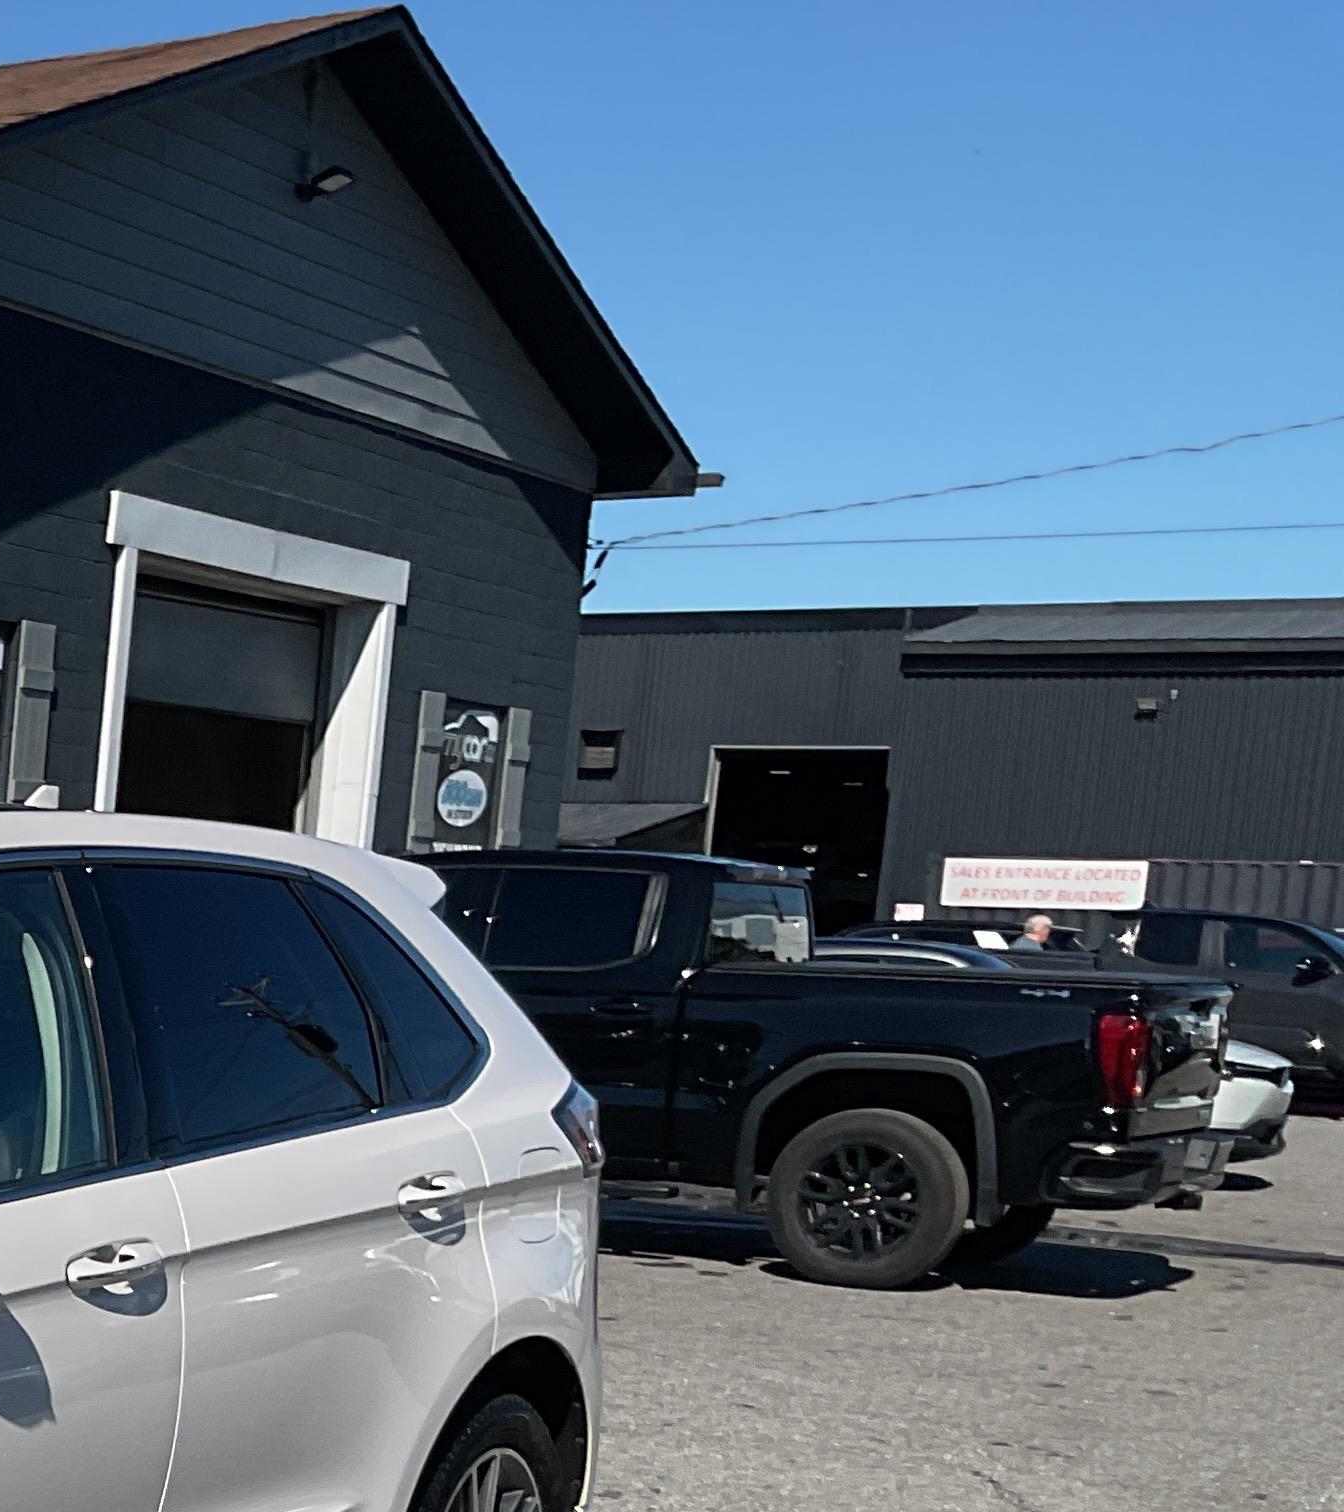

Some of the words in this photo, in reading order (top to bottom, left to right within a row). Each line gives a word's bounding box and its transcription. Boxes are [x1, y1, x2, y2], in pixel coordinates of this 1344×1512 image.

[950, 865, 991, 879] SALES
[995, 866, 1072, 881] ENTRANCE
[1074, 868, 1142, 882] LOCATED
[959, 887, 978, 899] AT
[981, 888, 1030, 901] FRONT
